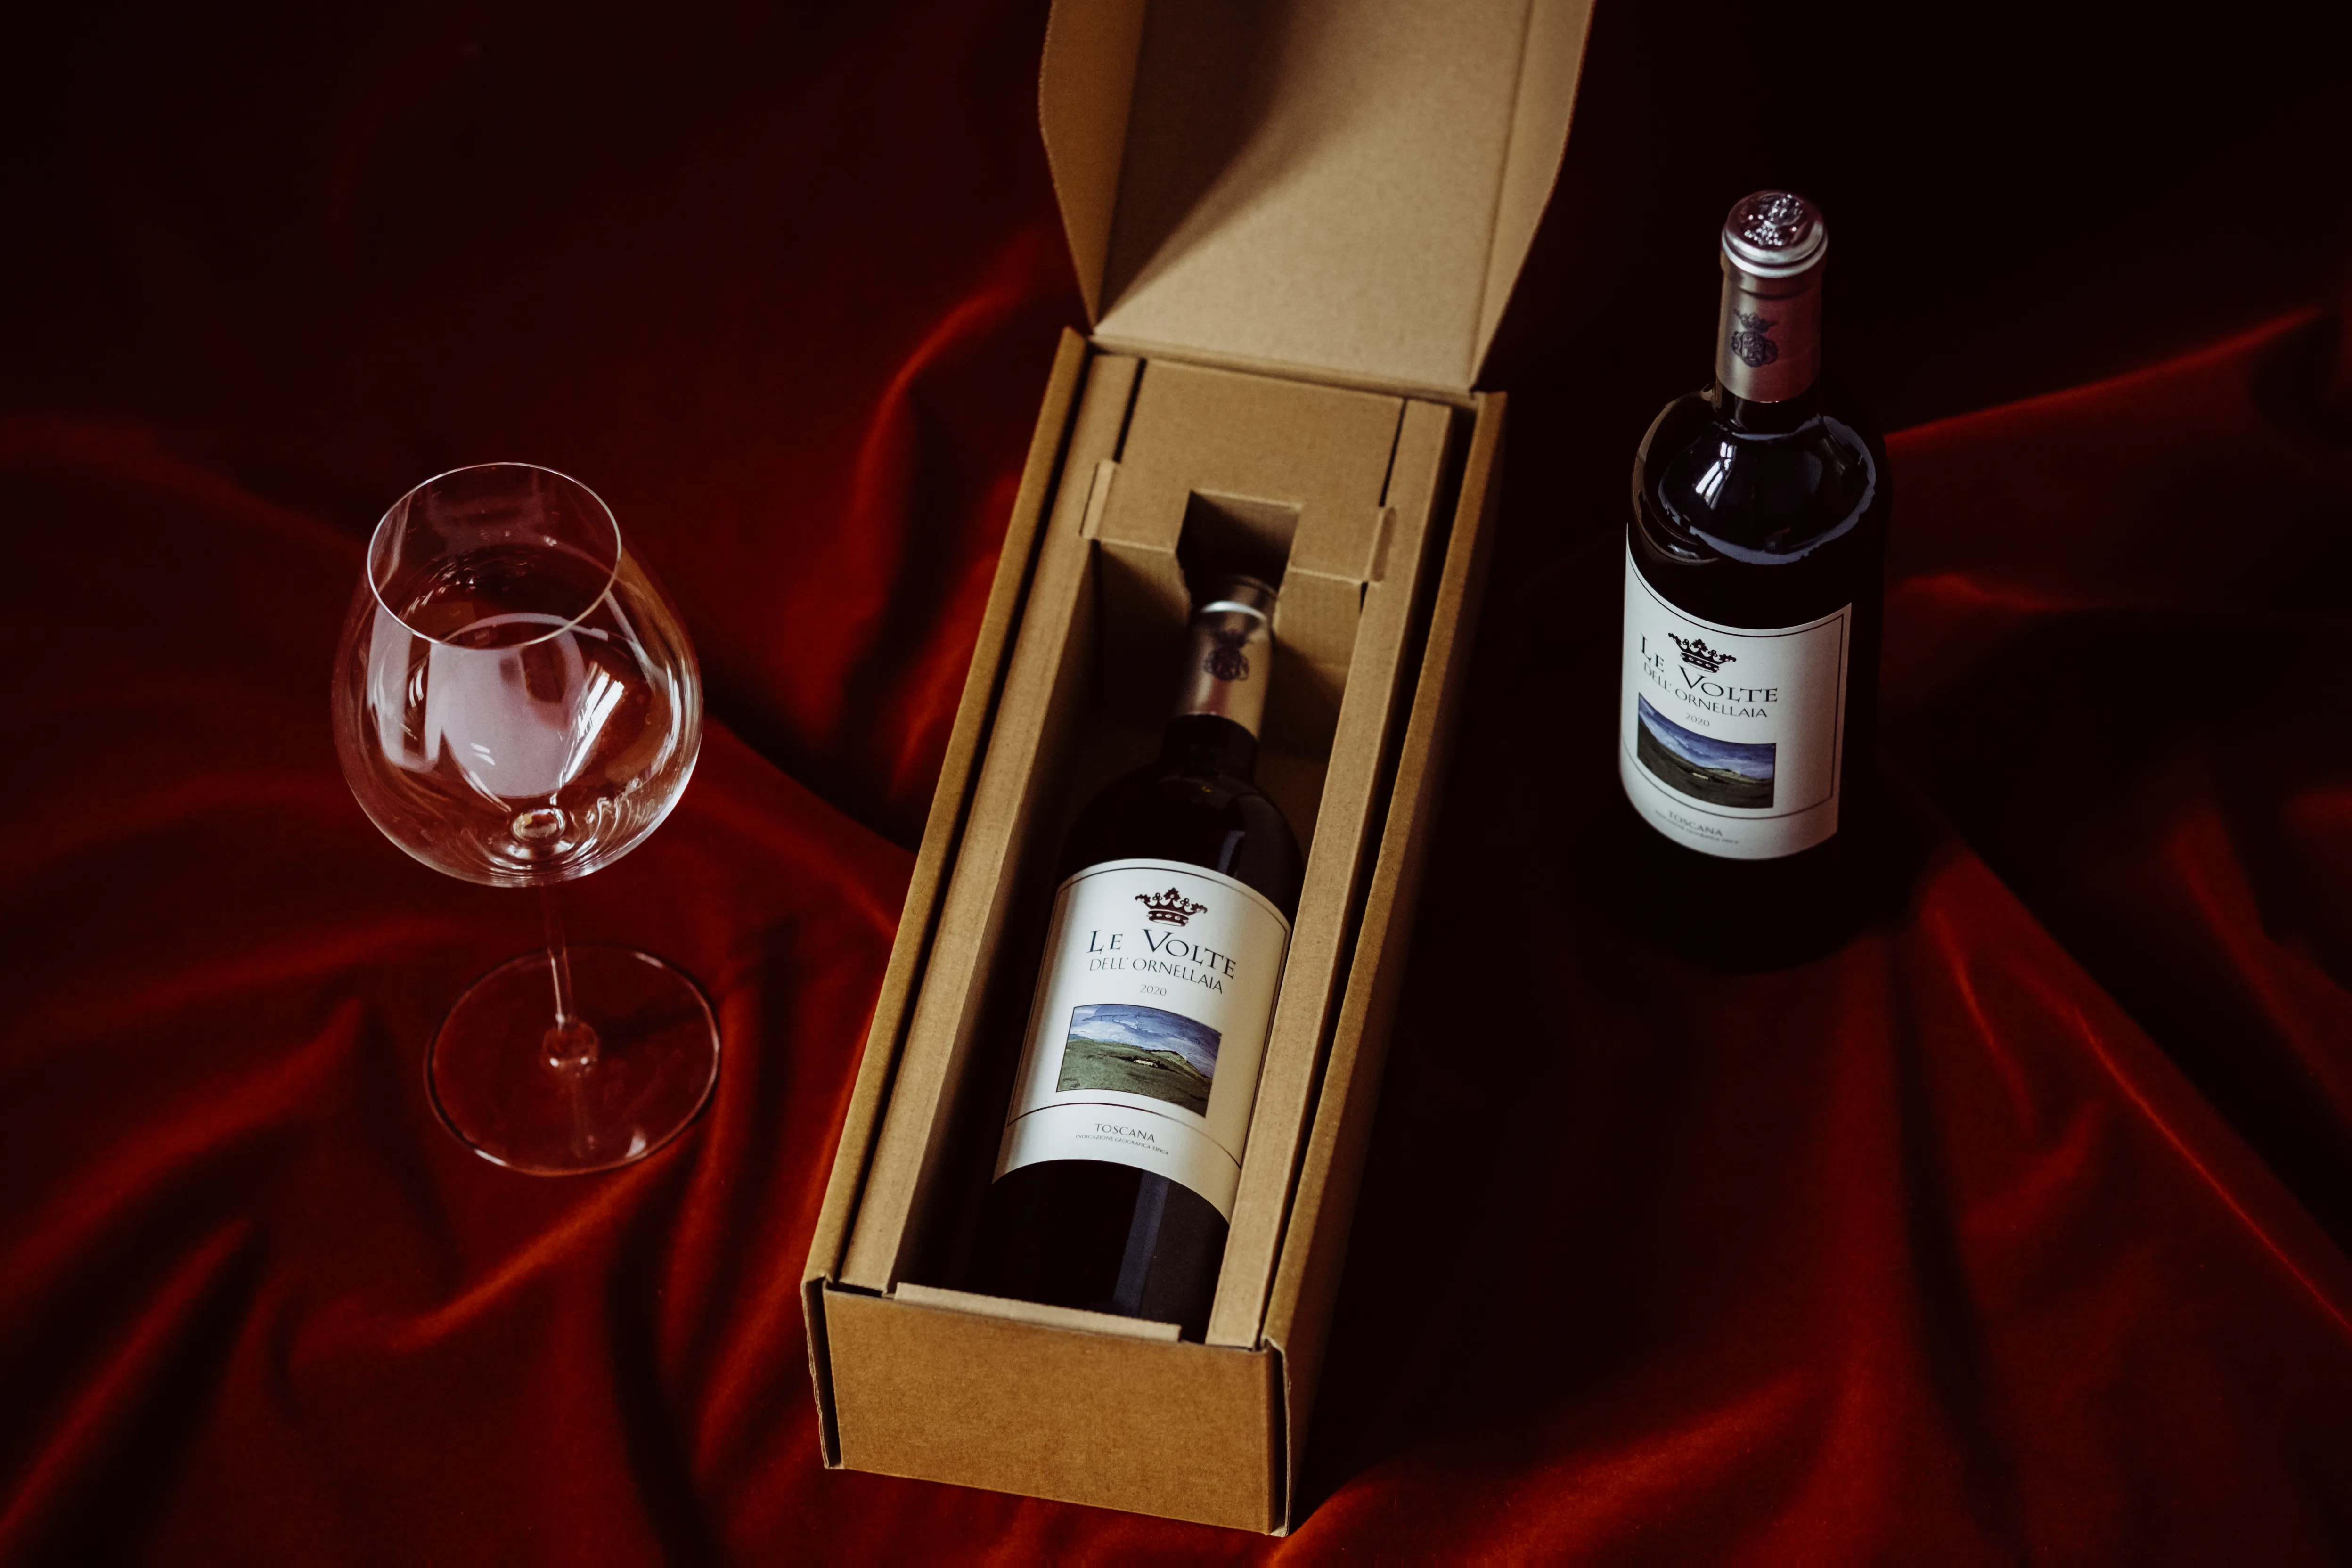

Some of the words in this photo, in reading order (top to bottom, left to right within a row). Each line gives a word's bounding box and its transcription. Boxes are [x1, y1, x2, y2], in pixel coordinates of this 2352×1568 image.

[1640, 632, 1664, 672] LE
[1678, 664, 1778, 703] VOLTE
[1644, 662, 1672, 692] DELL'
[1675, 688, 1767, 718] ORNELLAIA
[1685, 712, 1710, 727] 2020
[1668, 810, 1723, 836] TOSCANA
[1086, 930, 1123, 954] LE
[1142, 929, 1236, 979] VOLTE
[1089, 957, 1128, 971] DELL'
[1133, 958, 1223, 994] ORNELLAIA
[1140, 984, 1167, 996] 2020
[1095, 1124, 1155, 1143] TOSCANA
[1115, 1137, 1151, 1149] GEOGRAFICA
[1152, 1146, 1169, 1155] TIPICA
